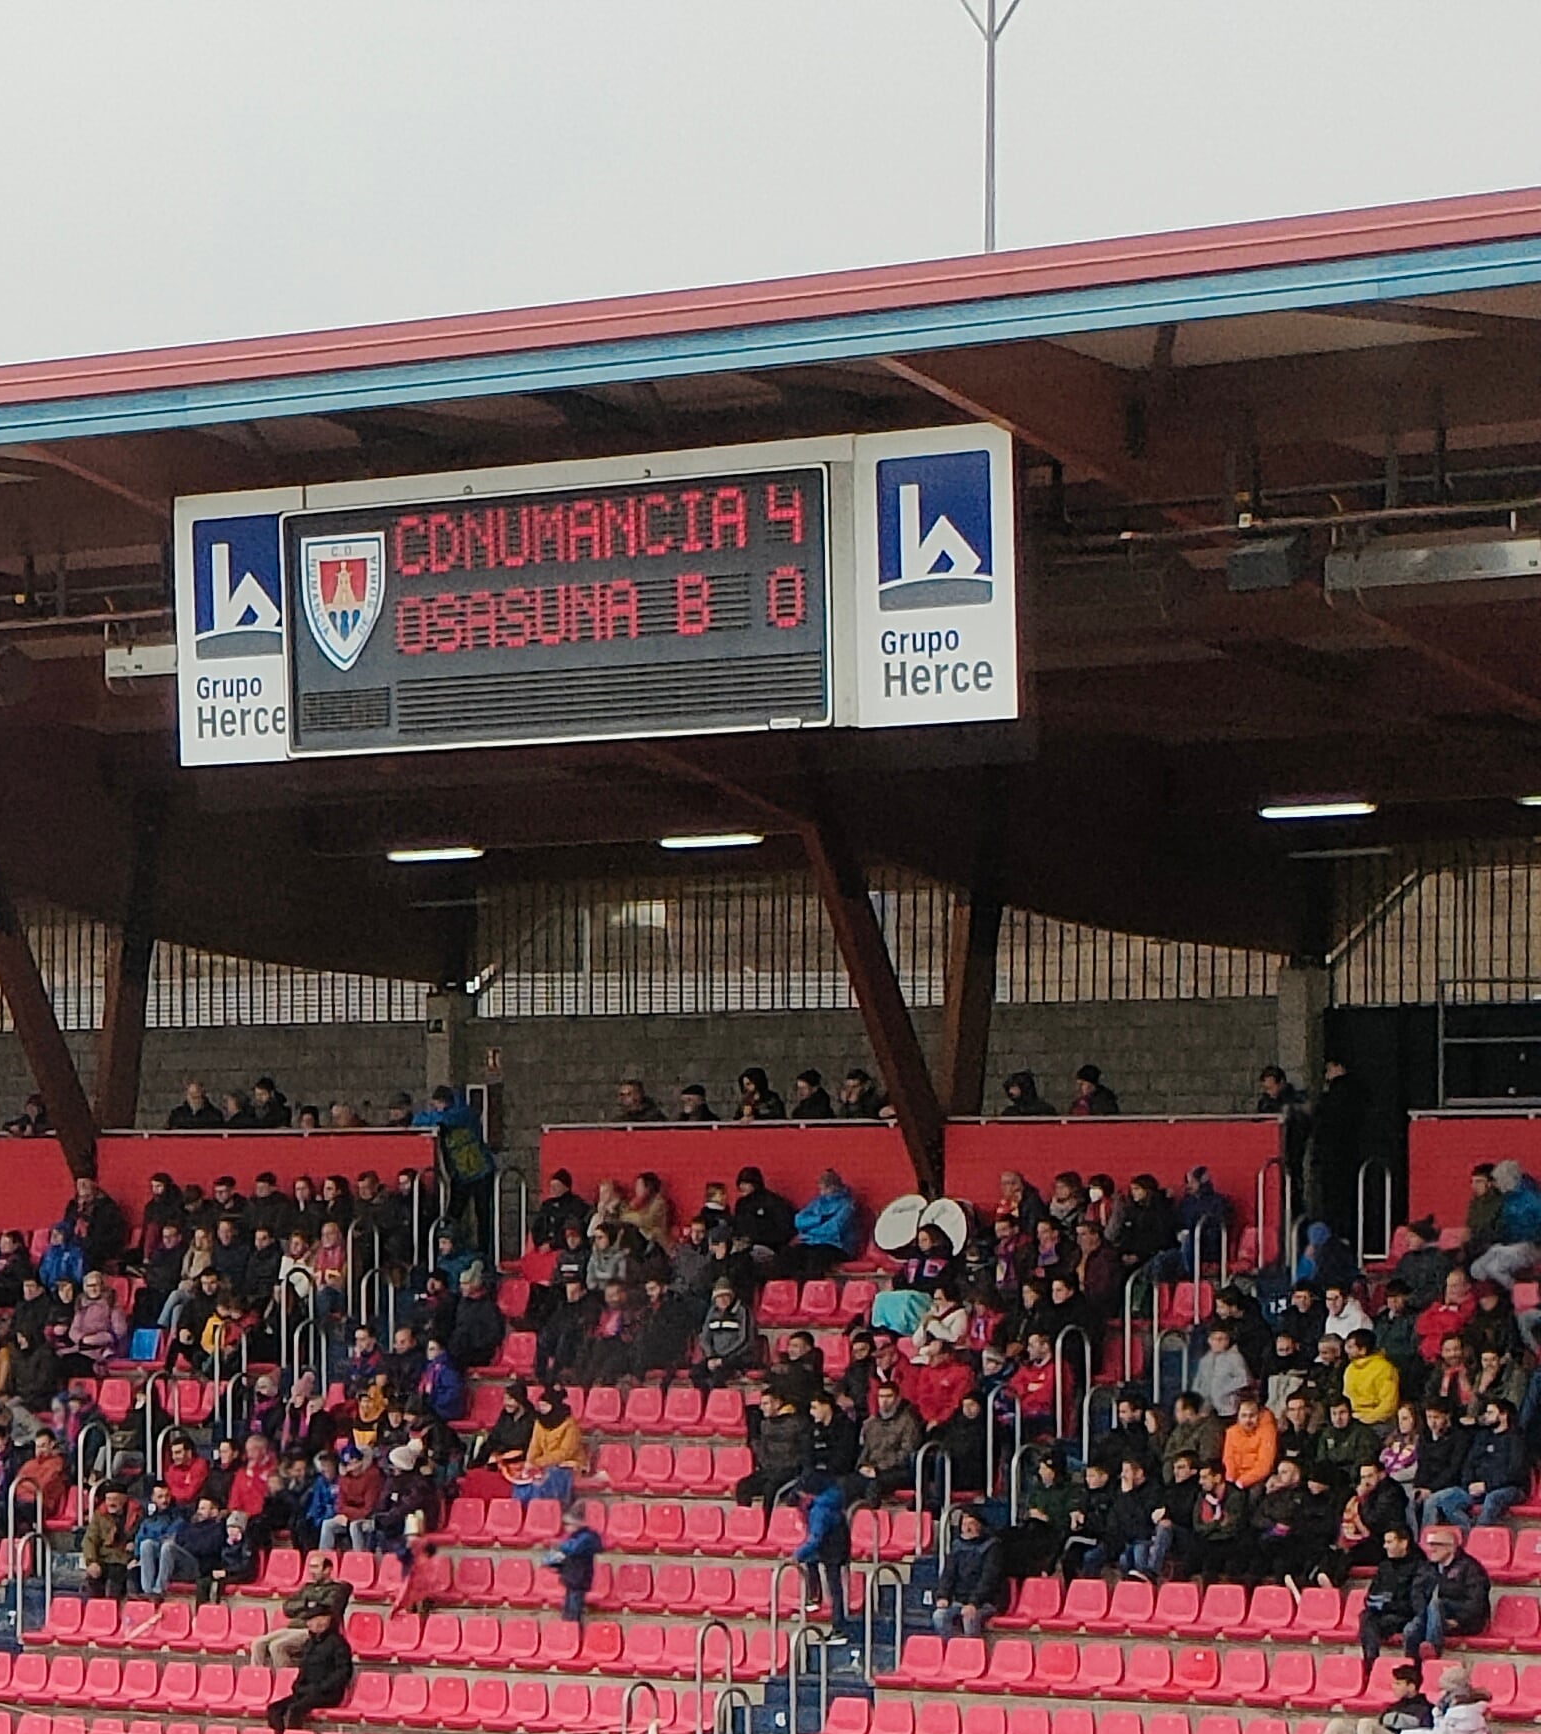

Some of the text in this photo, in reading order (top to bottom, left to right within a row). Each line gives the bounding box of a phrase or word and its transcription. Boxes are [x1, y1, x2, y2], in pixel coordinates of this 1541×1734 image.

[394, 483, 804, 577] CDNUMANCIA 4
[394, 580, 640, 657] OSASUNA
[675, 573, 716, 638] B
[880, 628, 960, 659] Grupo
[195, 676, 263, 703] Grupo
[882, 659, 995, 699] Herce
[195, 704, 287, 740] Herce
